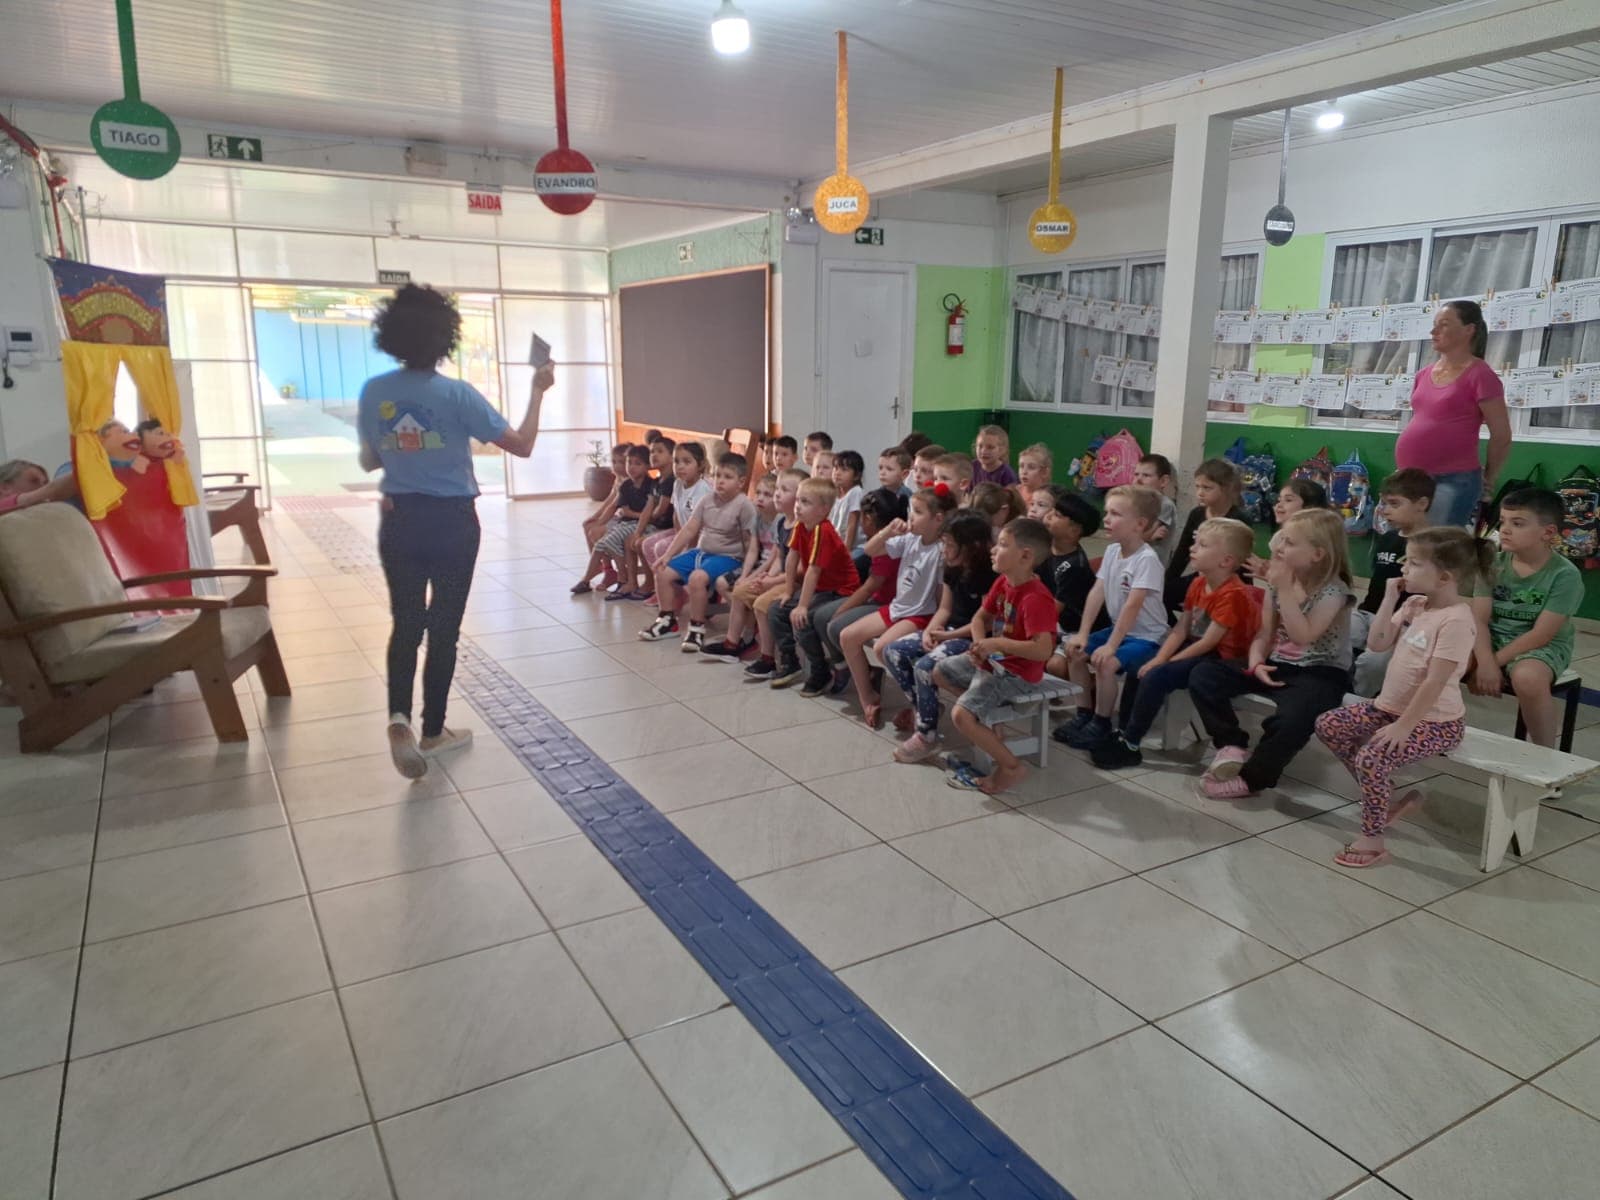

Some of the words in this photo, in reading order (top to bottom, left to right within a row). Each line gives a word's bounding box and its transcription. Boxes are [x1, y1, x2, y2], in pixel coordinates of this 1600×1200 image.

[109, 129, 160, 146] TIAGO
[536, 177, 595, 188] EVANDRO
[830, 199, 857, 209] JUCA
[1036, 224, 1069, 233] OSMAR
